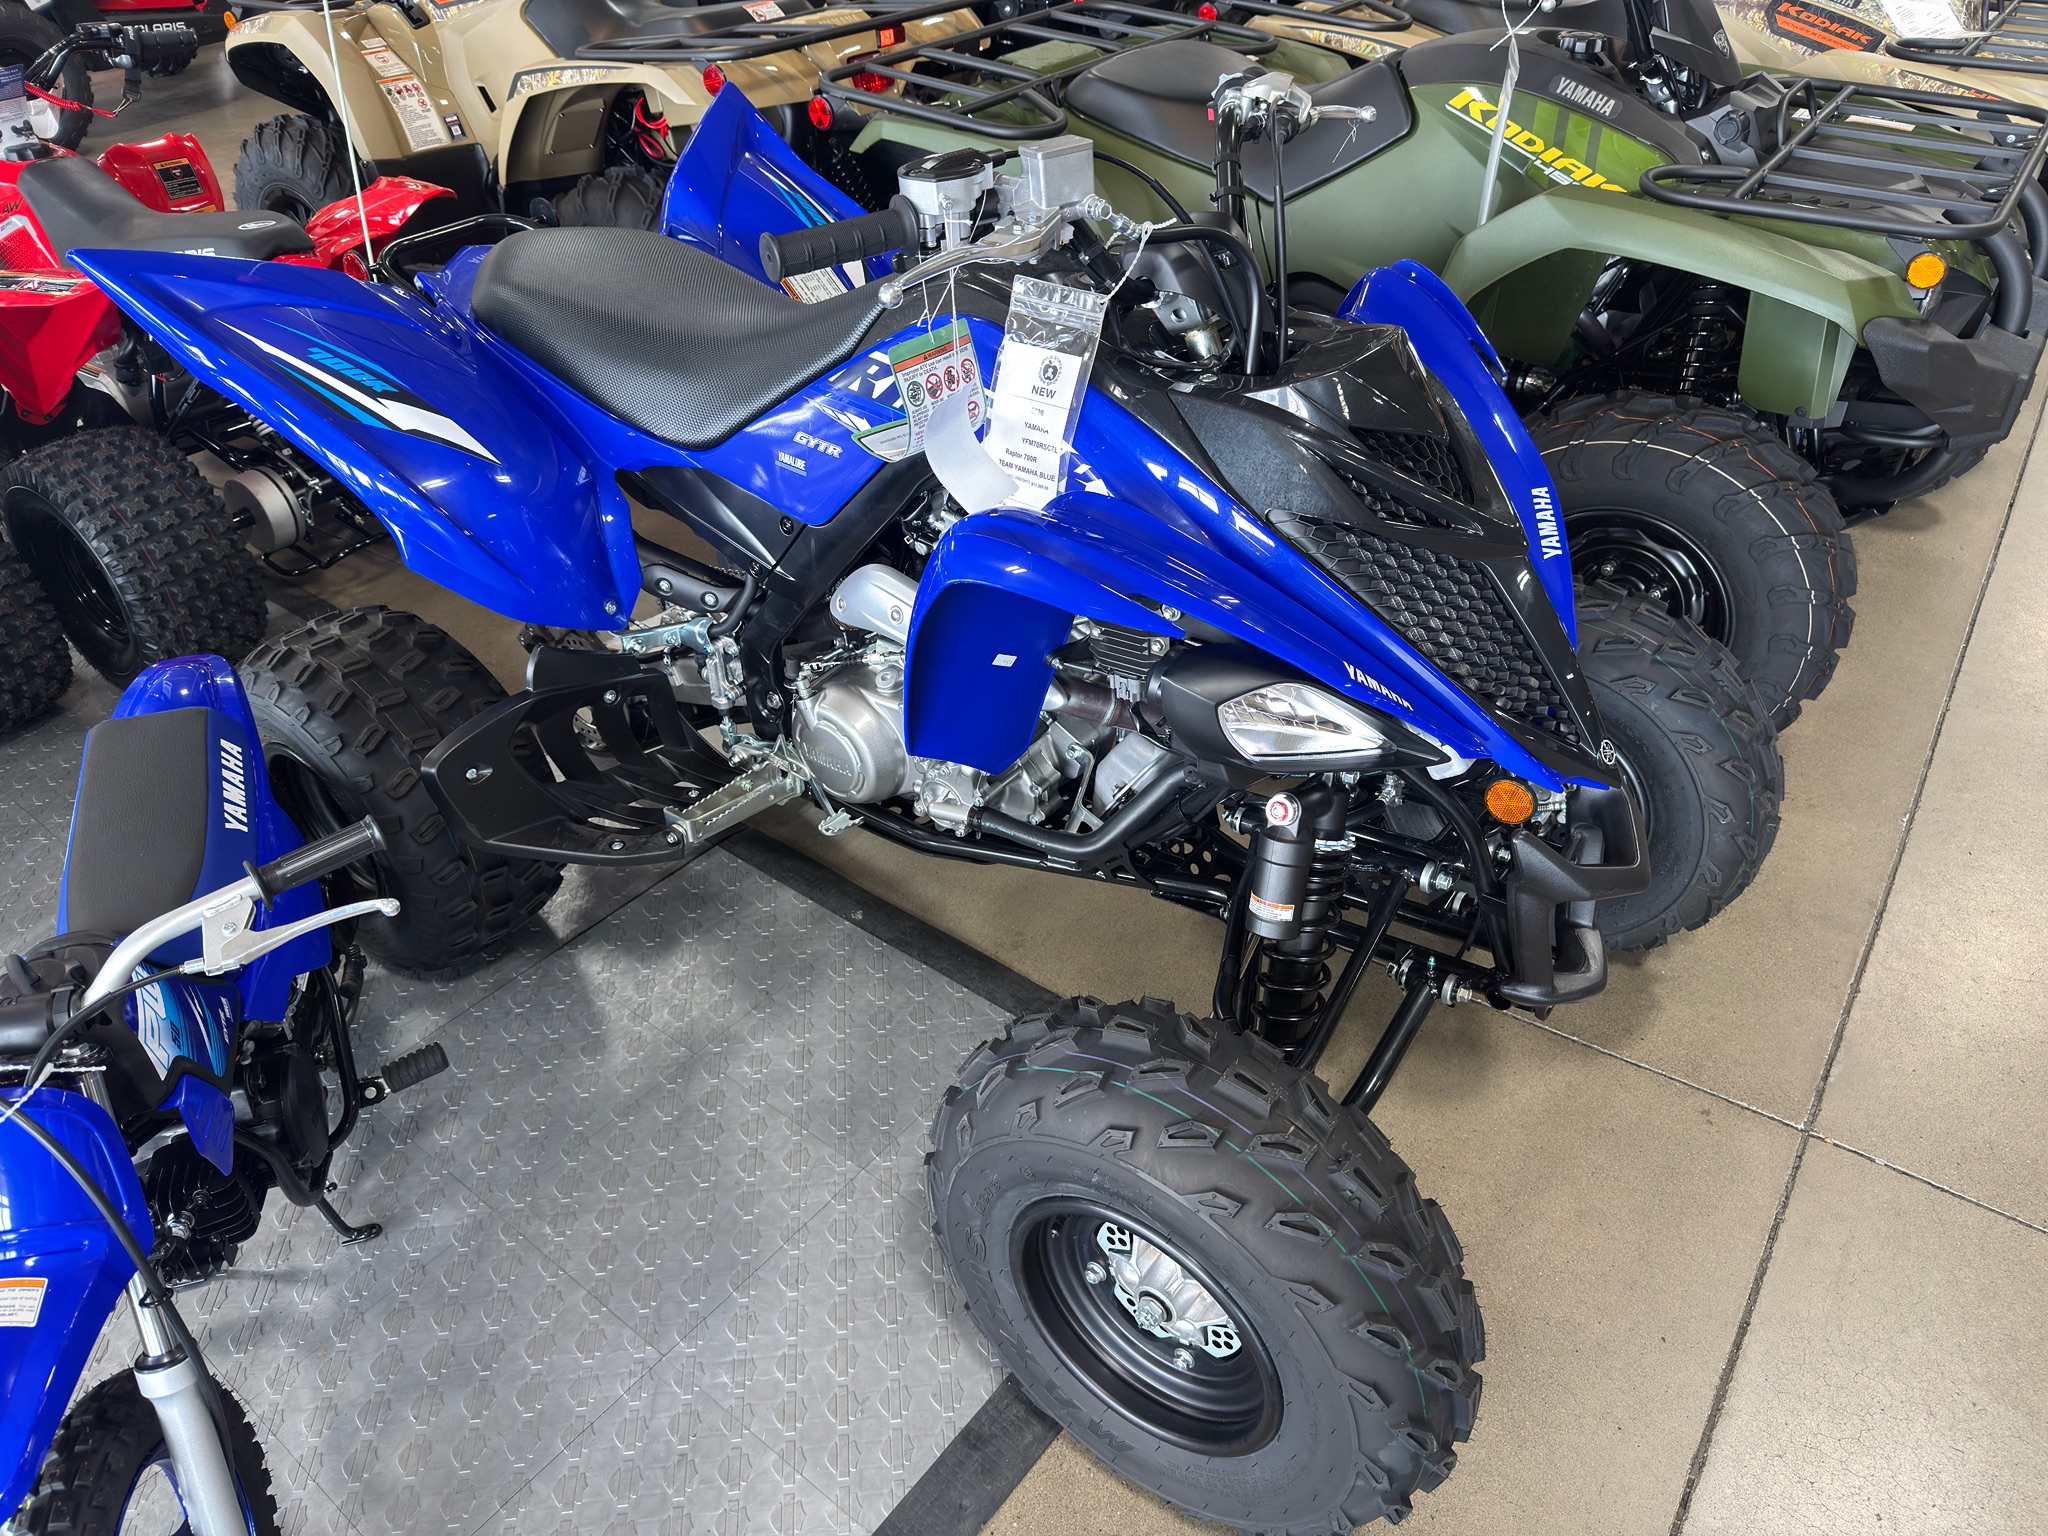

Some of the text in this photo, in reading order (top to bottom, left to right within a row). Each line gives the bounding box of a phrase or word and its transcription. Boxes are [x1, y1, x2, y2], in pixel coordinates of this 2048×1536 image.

[123, 22, 186, 33] LARIS
[1777, 2, 1874, 45] KODIAK
[1782, 20, 1851, 49] POWER STEERING
[1555, 76, 1616, 117] YAMAHA
[1448, 89, 1628, 193] KODIAK
[1533, 159, 1580, 186] 45
[901, 367, 920, 378] Improper
[919, 362, 928, 371] ATV
[955, 346, 969, 356] SVERE
[928, 346, 948, 359] WARNING
[307, 347, 399, 393] 700R
[1031, 385, 1057, 399] NEW
[1024, 421, 1049, 435] YAMAHA
[793, 431, 843, 458] GYTR
[1005, 447, 1038, 463] Raptor 700R
[1021, 436, 1059, 454] YFM70RSCTL
[778, 451, 806, 471] YAMALUBE
[998, 458, 1056, 482] TEAM YAMAHA BLUE
[1530, 486, 1563, 560] YAMAHA
[1342, 660, 1414, 712] YAMAHA
[220, 738, 248, 832] YAMAHA
[170, 1019, 182, 1052] 50
